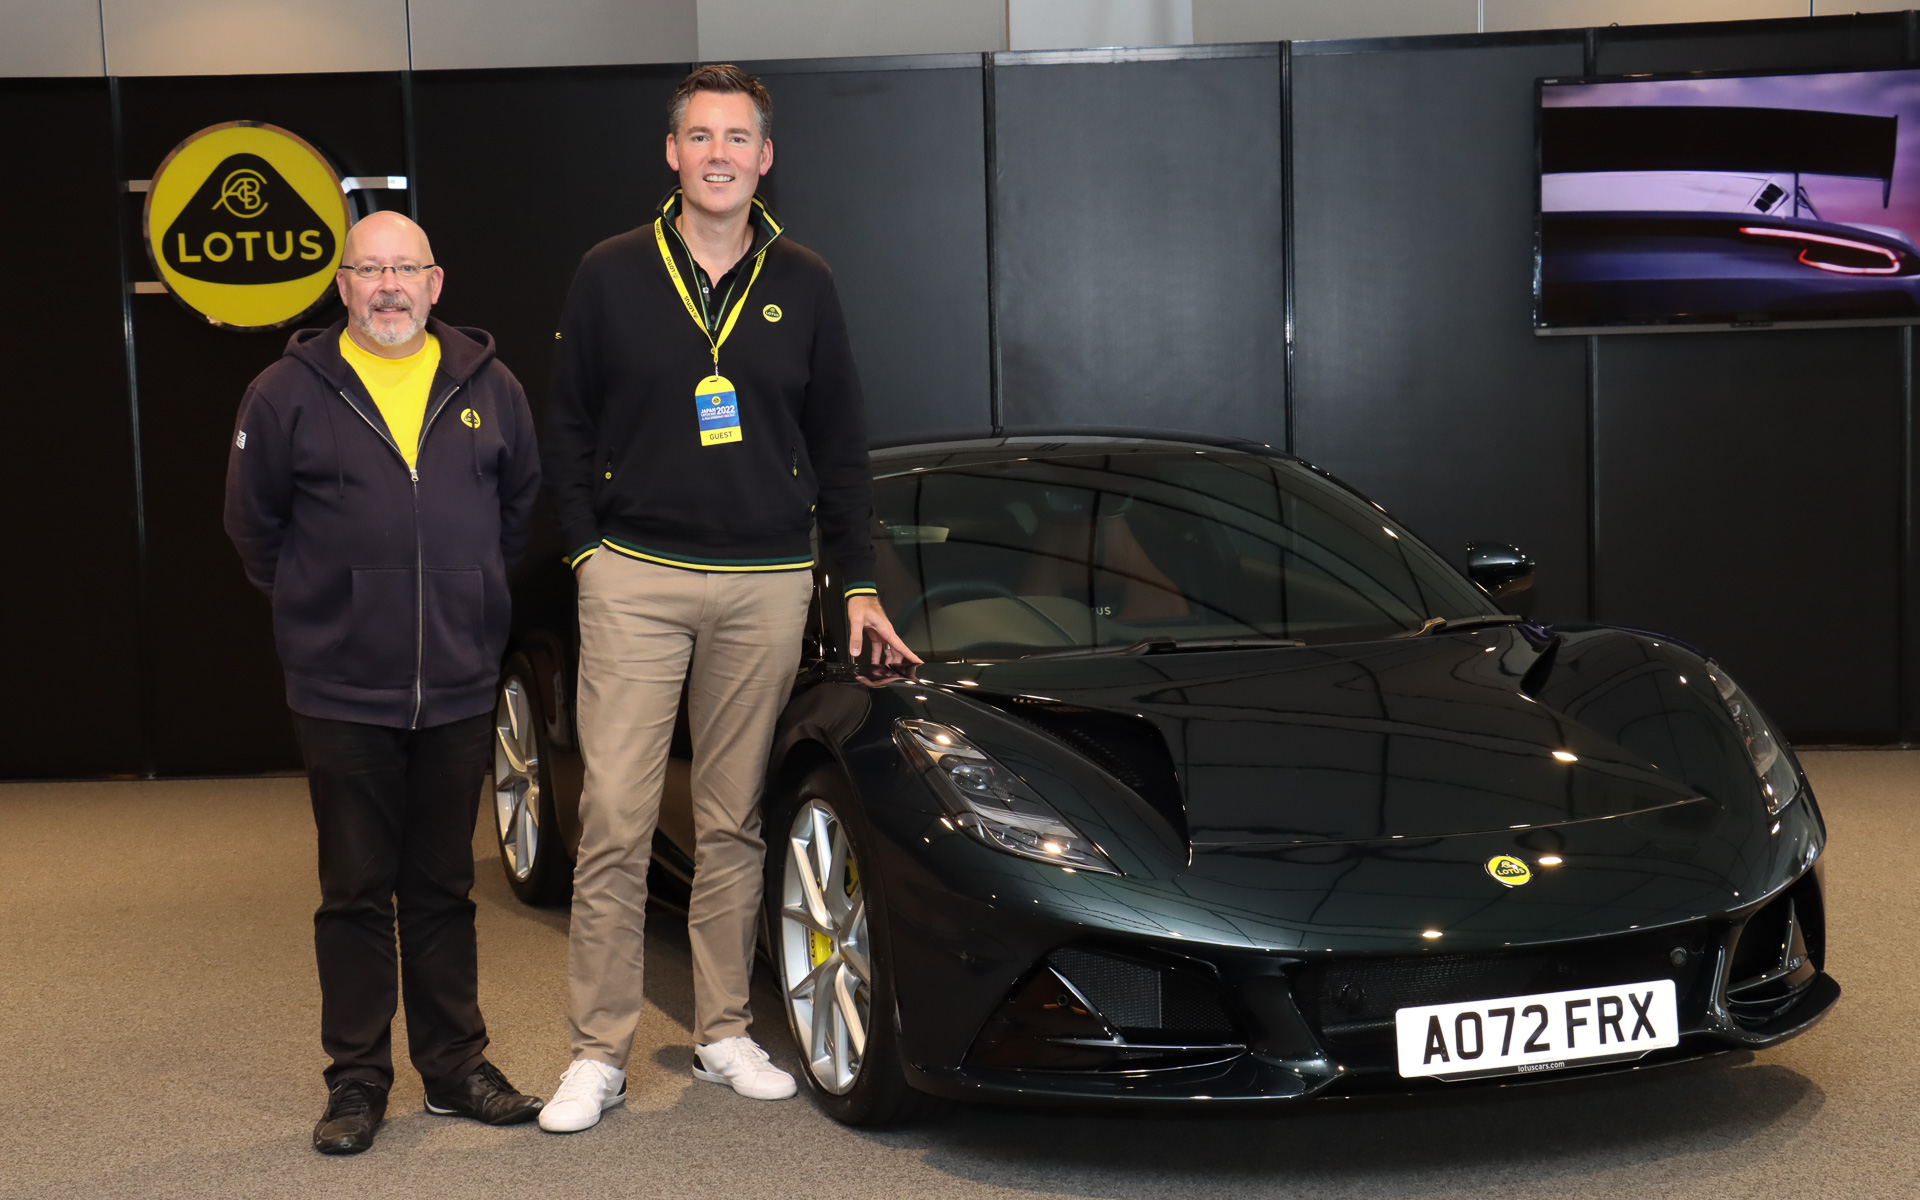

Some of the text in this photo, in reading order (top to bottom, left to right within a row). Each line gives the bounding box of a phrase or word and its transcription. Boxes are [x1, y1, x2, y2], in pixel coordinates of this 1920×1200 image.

[177, 229, 323, 263] LOTUS
[716, 404, 736, 415] 2022
[709, 431, 733, 440] GUEST
[1497, 867, 1526, 876] LOTUS
[1563, 990, 1657, 1050] FRX
[1517, 1061, 1565, 1073] lotuscars.com
